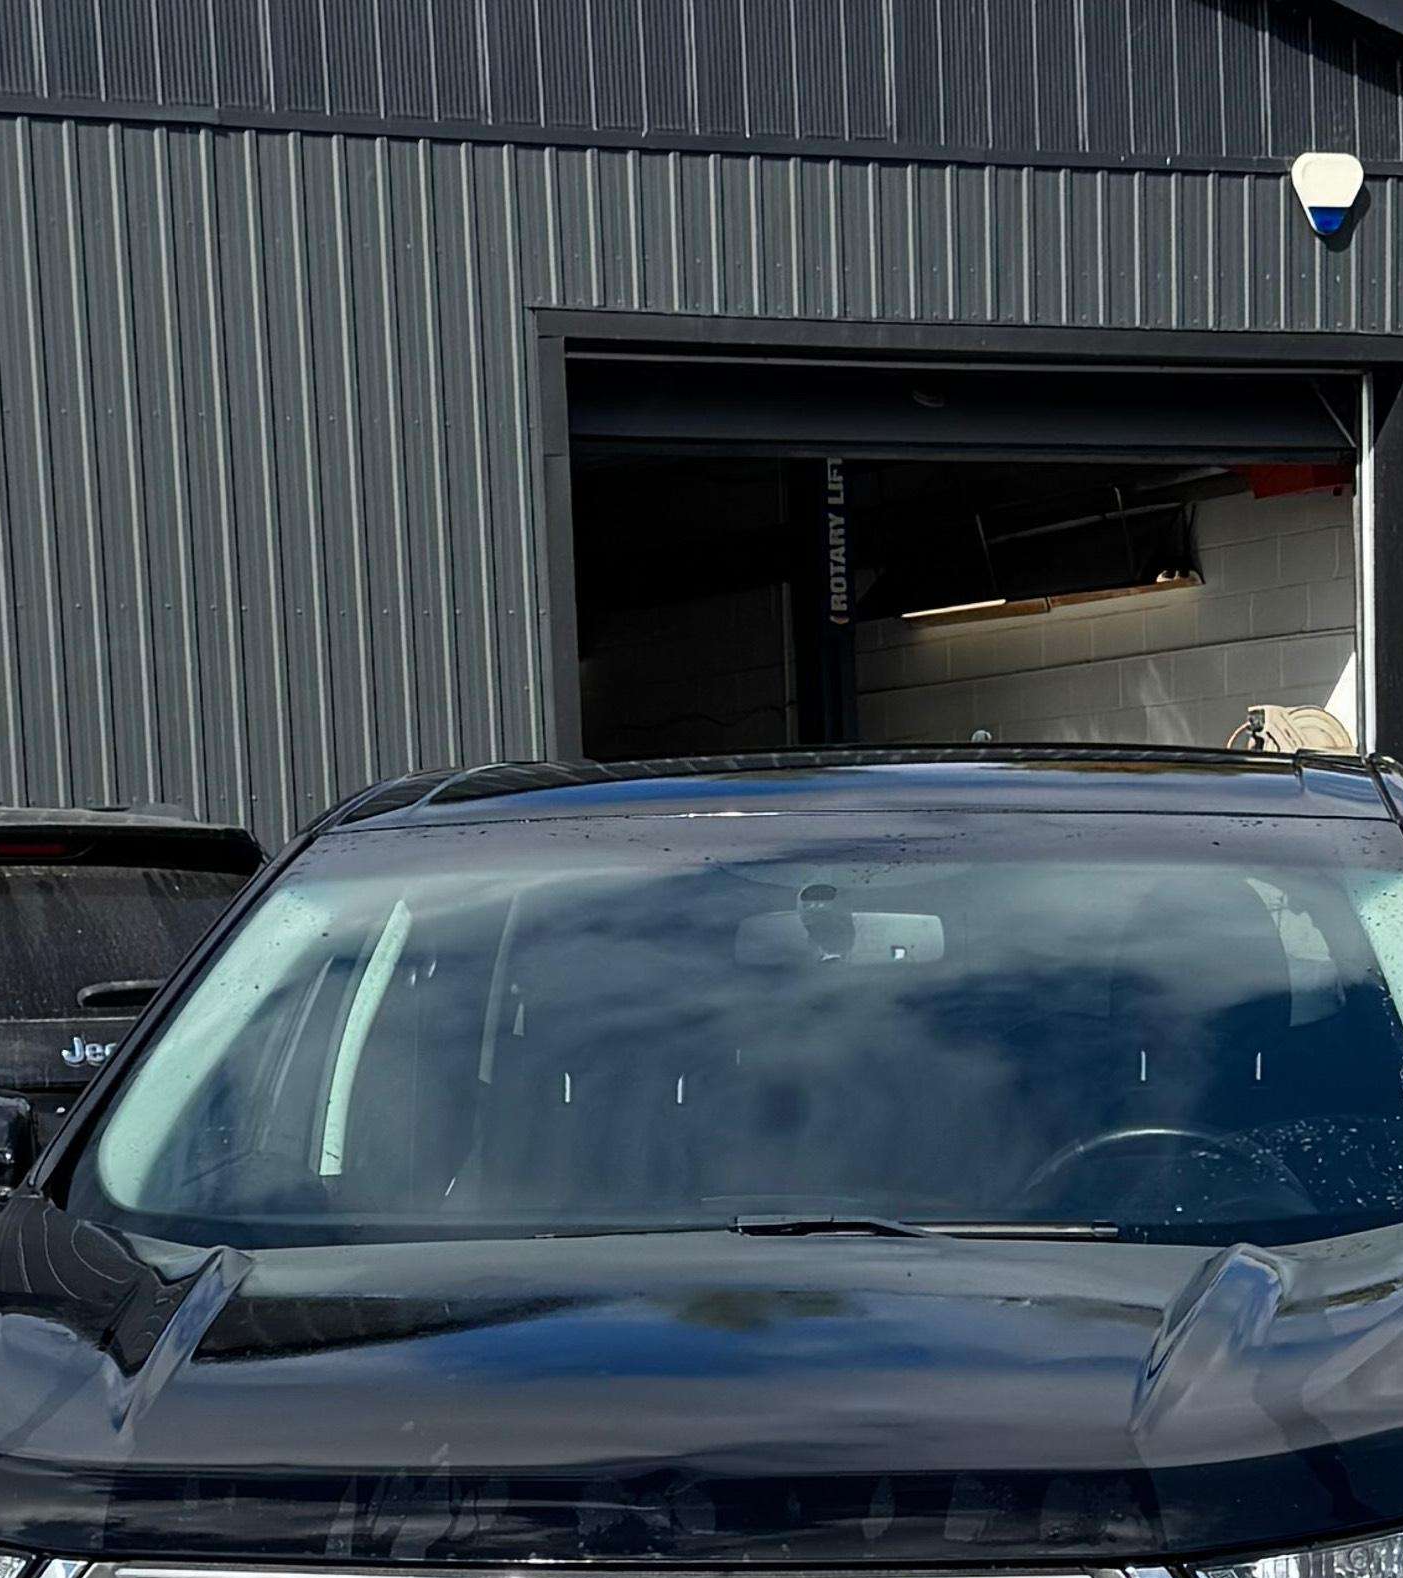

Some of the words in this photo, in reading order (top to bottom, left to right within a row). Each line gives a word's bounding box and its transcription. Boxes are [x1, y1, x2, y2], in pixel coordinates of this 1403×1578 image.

[826, 457, 845, 504] LIFT
[828, 512, 848, 611] ROTARY
[60, 1035, 118, 1067] Je
